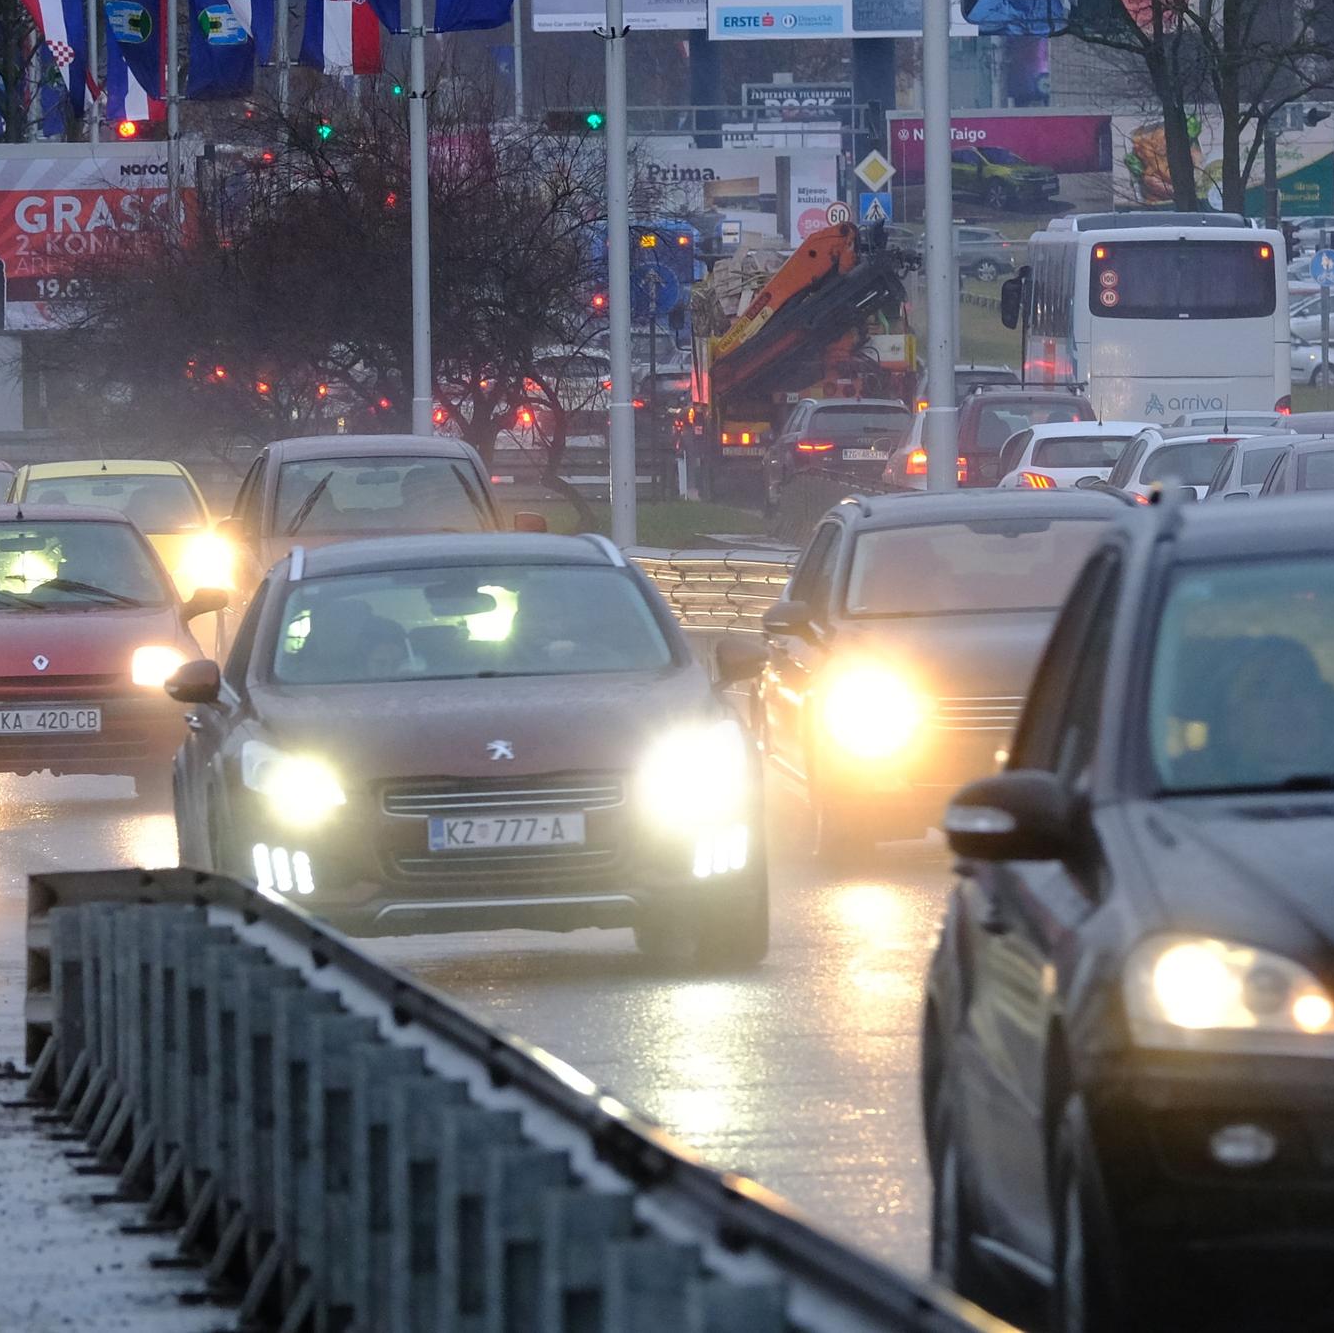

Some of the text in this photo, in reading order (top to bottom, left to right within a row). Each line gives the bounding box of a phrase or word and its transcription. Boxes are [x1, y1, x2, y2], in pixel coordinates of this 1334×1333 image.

[723, 16, 760, 28] ERSTE
[950, 126, 987, 143] Taigo
[120, 162, 185, 176] Narodi
[647, 164, 721, 182] Prima.
[797, 186, 828, 198] Mjesec
[830, 209, 846, 224] 60
[15, 234, 38, 256] 2.
[1168, 393, 1223, 411] arriva
[0, 711, 98, 730] KA 420-CB
[493, 817, 565, 843] 777-A
